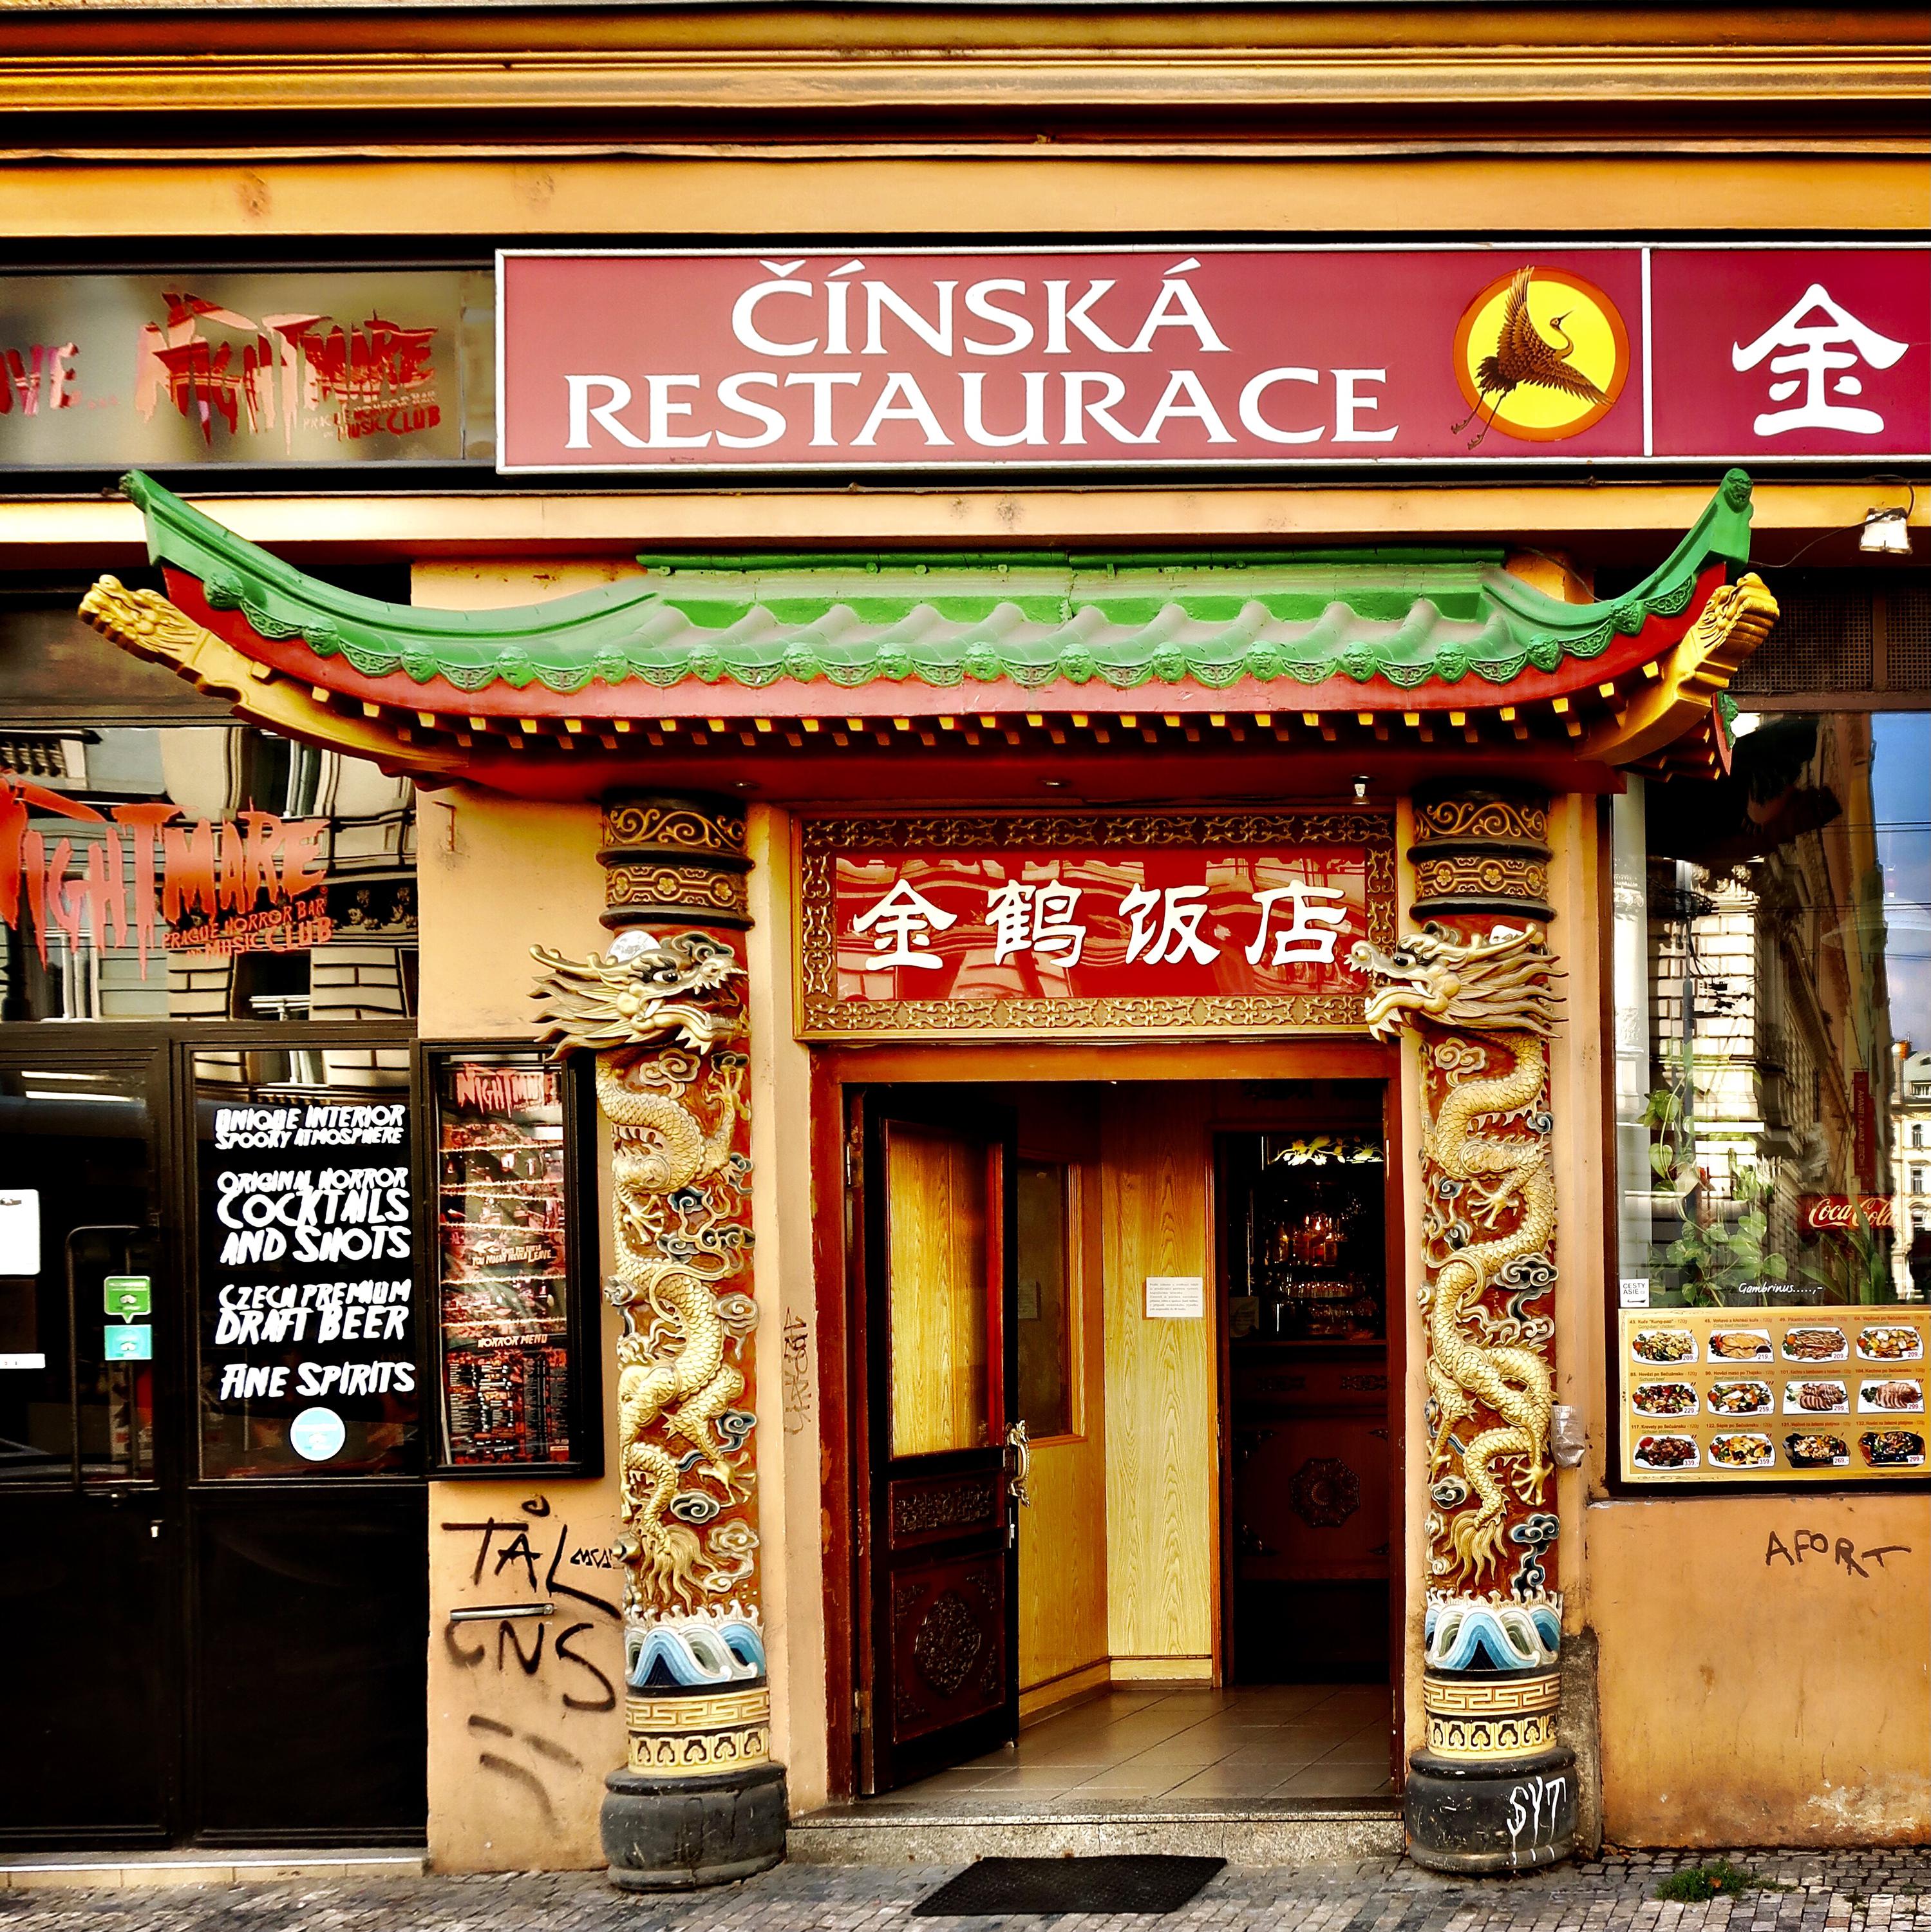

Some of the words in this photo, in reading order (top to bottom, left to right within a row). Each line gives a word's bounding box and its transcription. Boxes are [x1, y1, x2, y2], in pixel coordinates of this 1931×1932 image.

[732, 257, 1230, 358] ČÍNSKÁ
[1732, 283, 1909, 437] 金
[386, 405, 440, 435] CLUB
[563, 368, 1399, 450] RESTAURACE
[162, 923, 219, 949] PRAGUE
[225, 905, 292, 934] HORROR
[296, 898, 327, 920] BAR
[205, 932, 263, 961] MUSIC
[265, 917, 332, 952] CLUB
[852, 878, 1347, 970] 金鹤饭店
[216, 1108, 301, 1132] UNIQUE
[305, 1104, 405, 1128] INTERIOR
[215, 1130, 292, 1150] SPOOKY
[294, 1128, 404, 1146] ATMOSPHERE
[217, 1171, 312, 1193] ORIGINAL
[318, 1168, 408, 1190] HORROR
[217, 1186, 410, 1229] COCKTAILS
[220, 1227, 287, 1265] AND
[292, 1225, 411, 1262] SHOTS
[218, 1284, 297, 1311] CZECH
[300, 1279, 411, 1307] PREMIUM
[215, 1307, 314, 1345] DRAFT
[317, 1305, 409, 1344] BEER
[220, 1363, 290, 1401] FINE
[296, 1360, 416, 1396] SPIRITS
